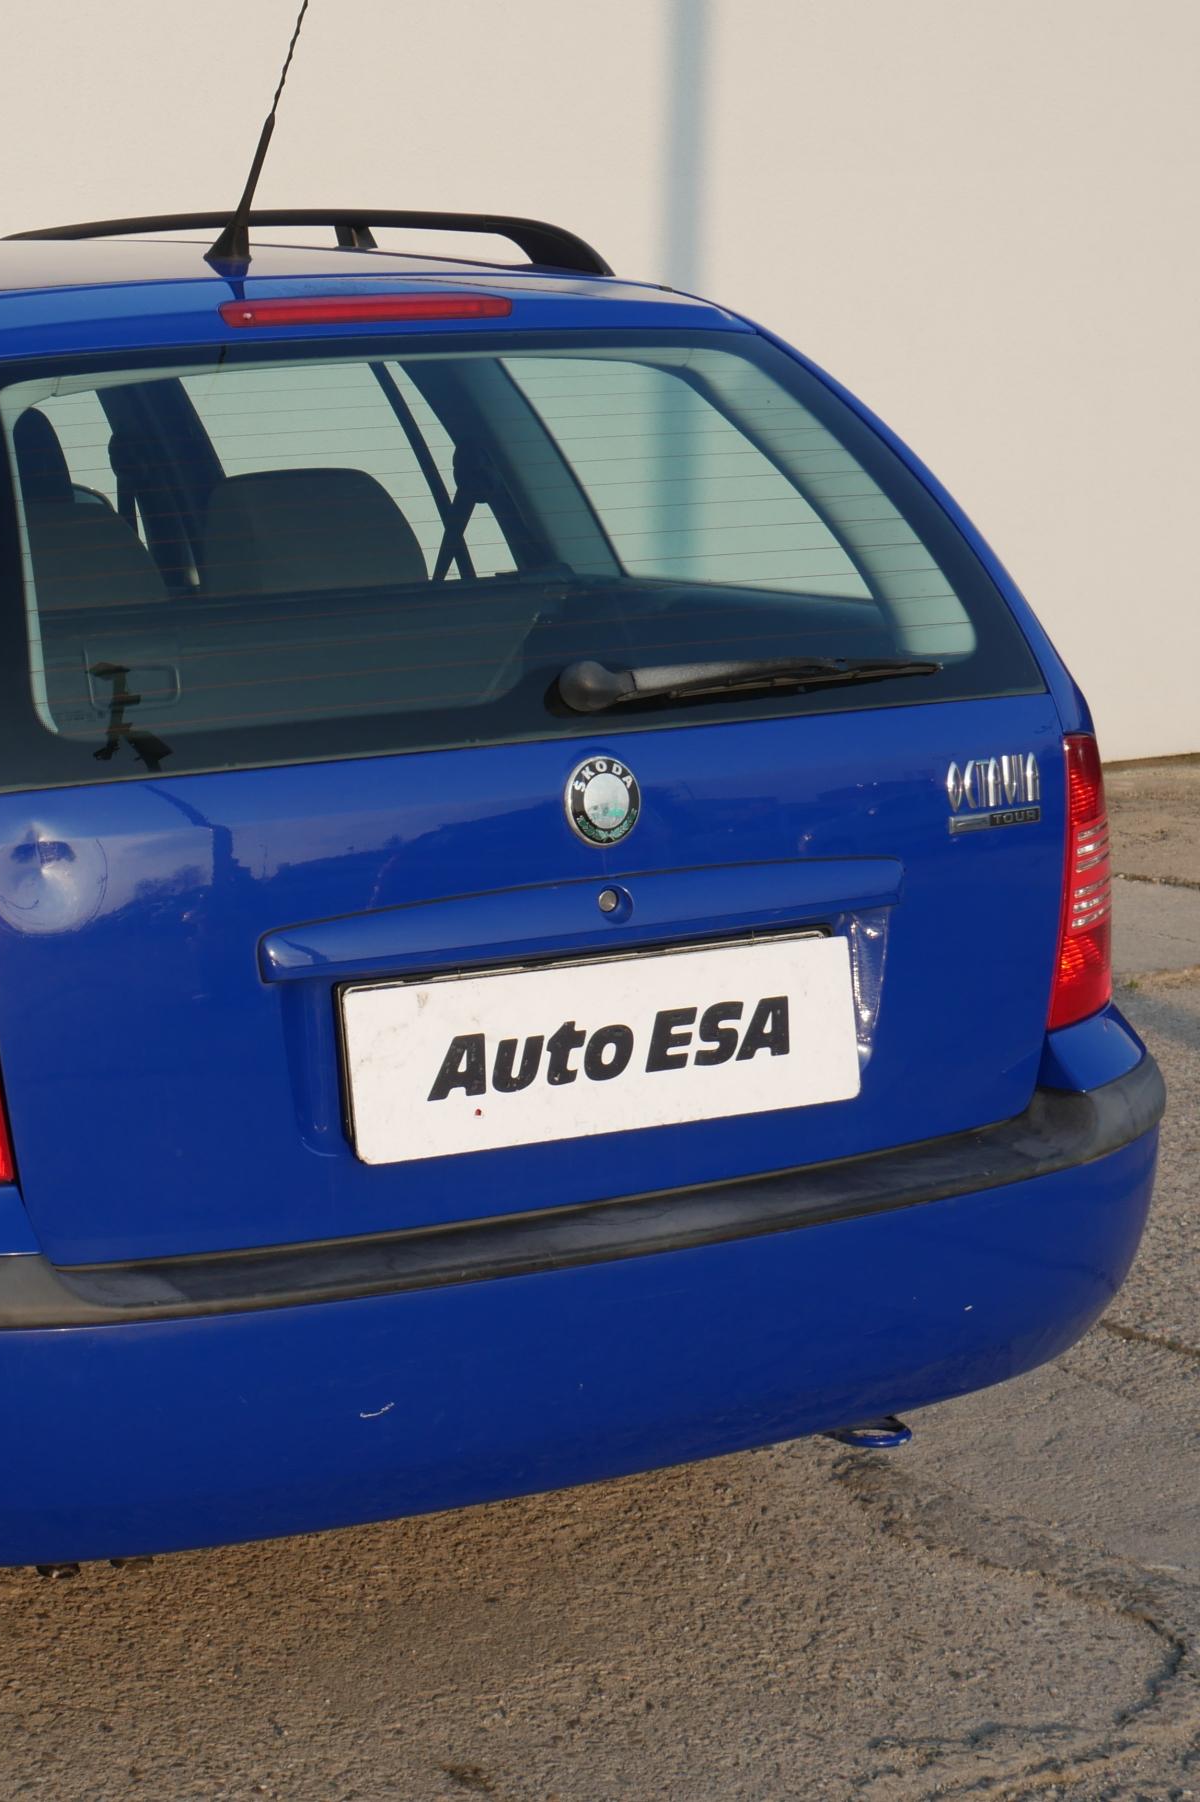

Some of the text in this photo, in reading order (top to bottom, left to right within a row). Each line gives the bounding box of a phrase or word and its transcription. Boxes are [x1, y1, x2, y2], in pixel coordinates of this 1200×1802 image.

[947, 752, 1040, 812] OCTAVIA
[993, 810, 1036, 824] TOUR
[427, 996, 790, 1102] Auto ESA
